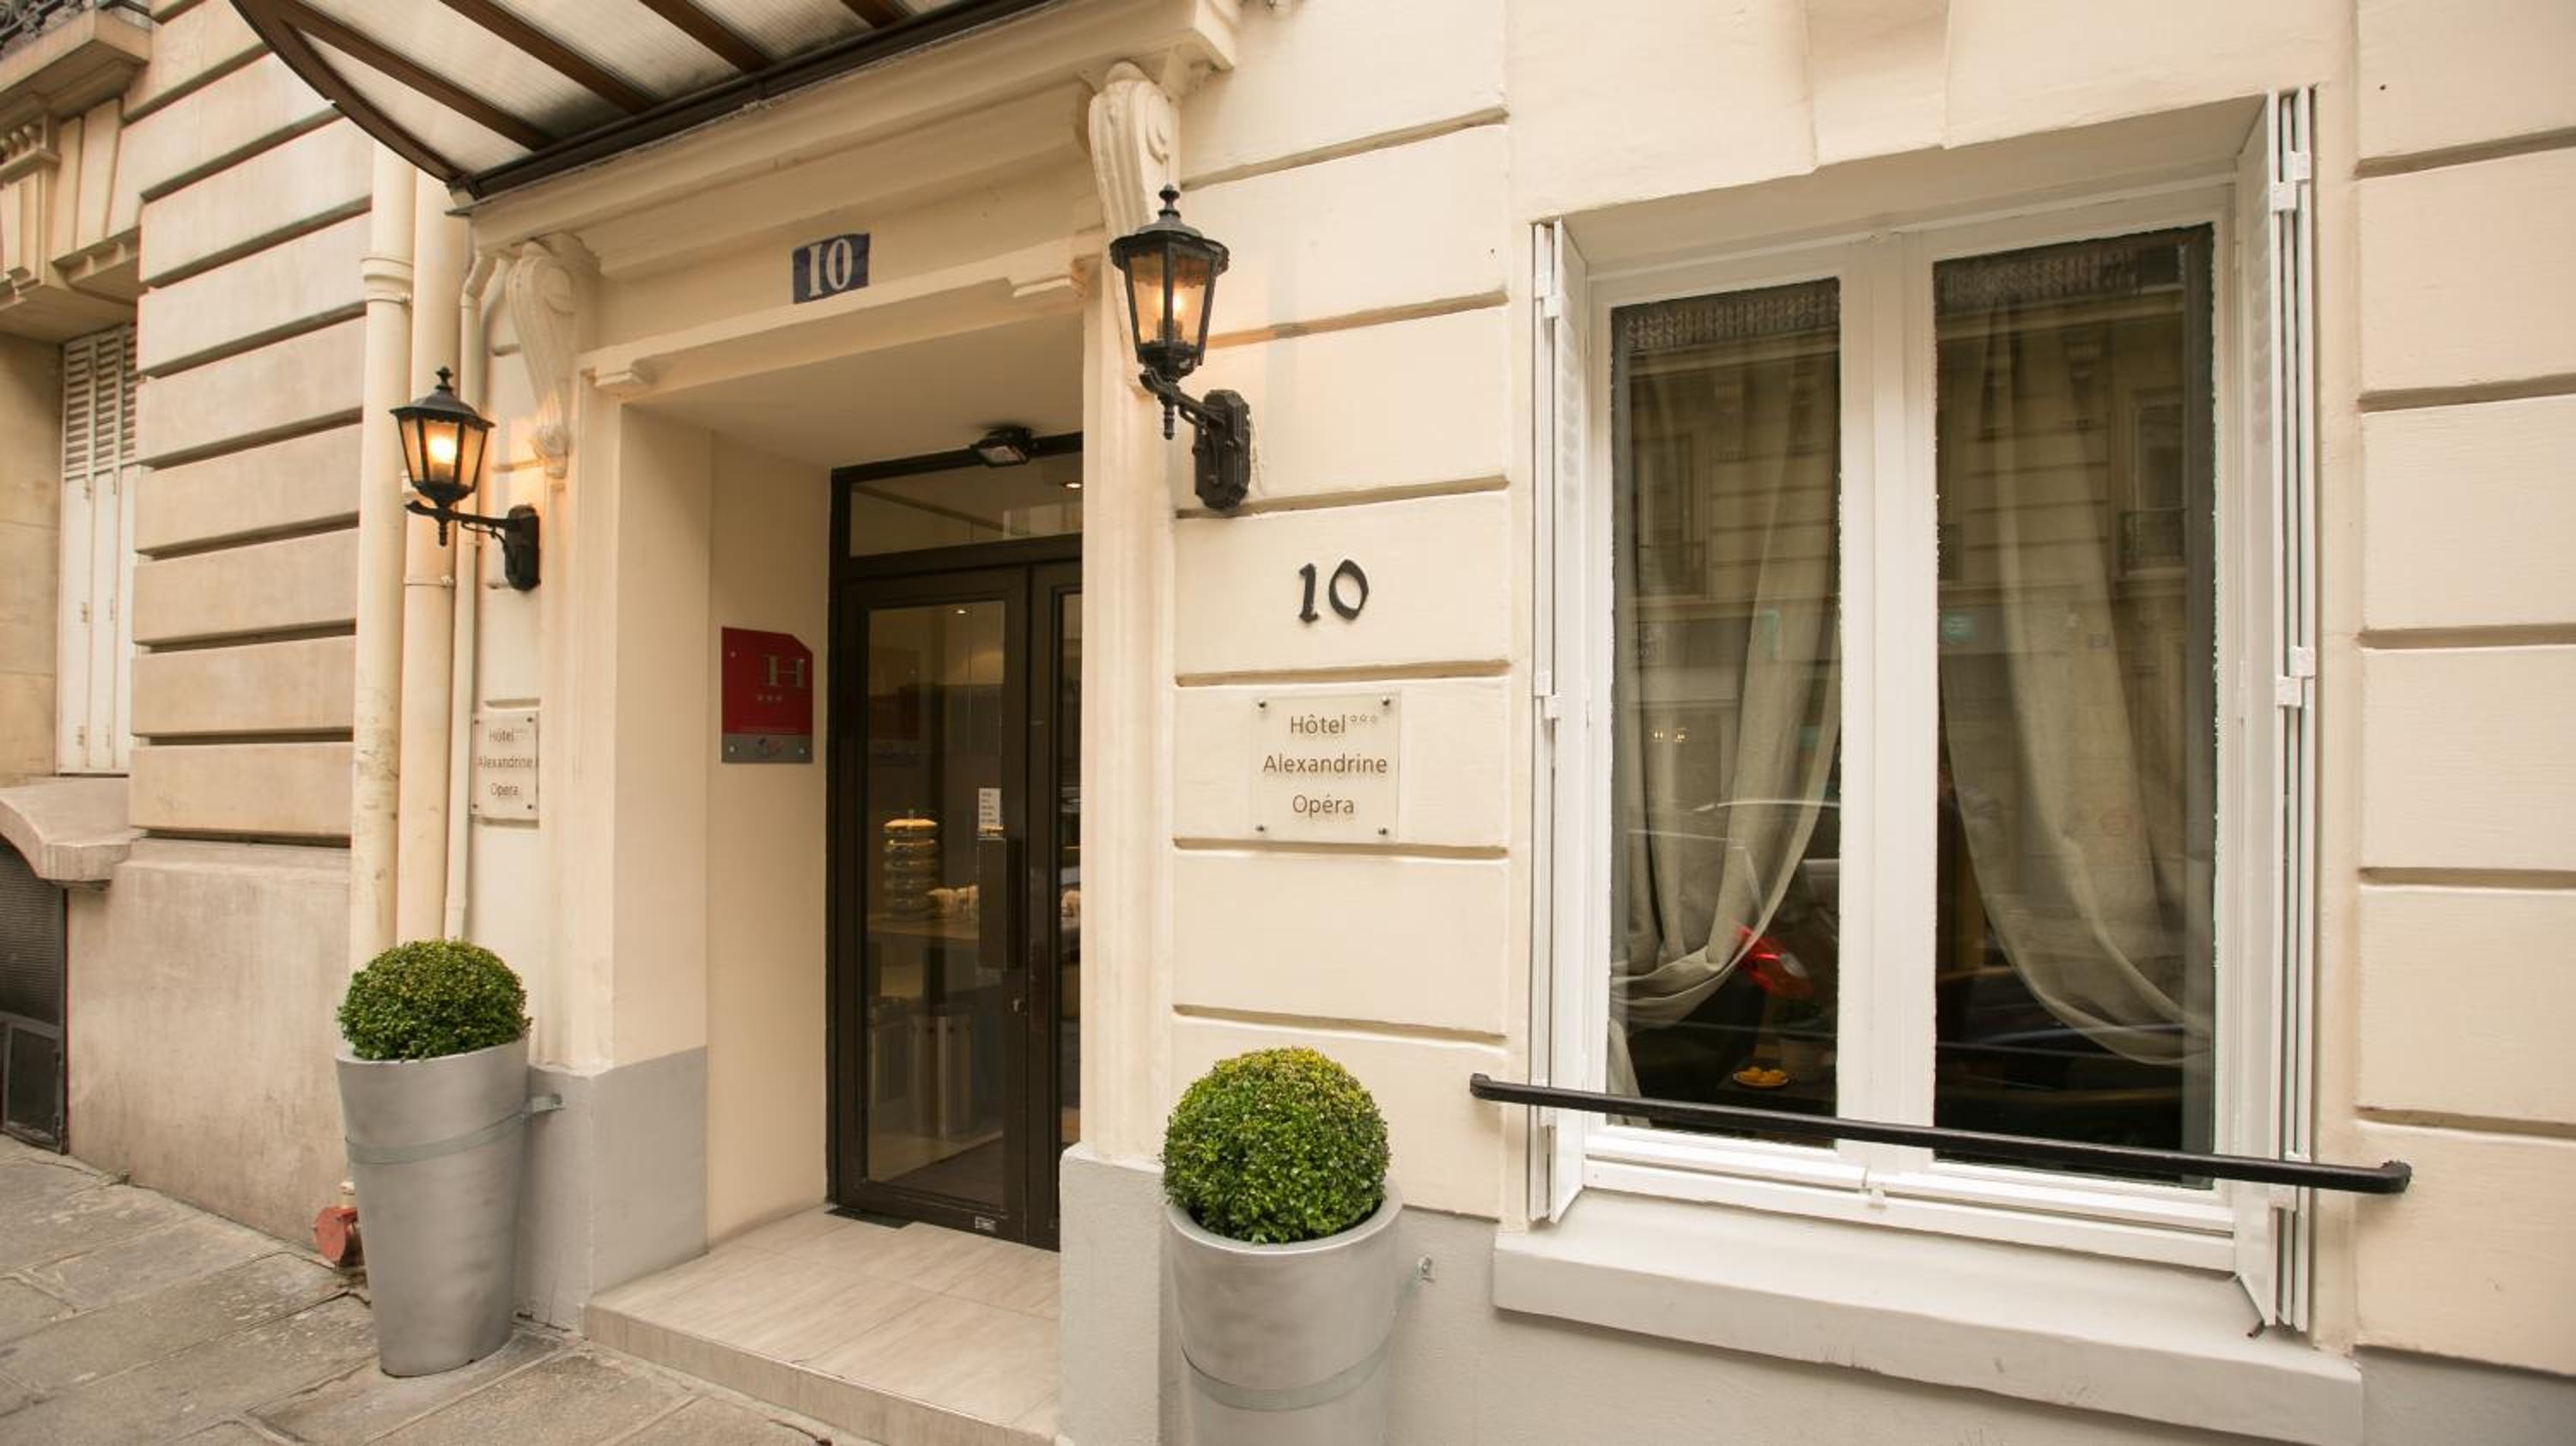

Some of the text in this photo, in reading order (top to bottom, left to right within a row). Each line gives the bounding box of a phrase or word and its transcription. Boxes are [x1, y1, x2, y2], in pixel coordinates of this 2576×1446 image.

[809, 237, 853, 297] 10
[1298, 558, 1370, 623] 10
[1291, 714, 1346, 734] Hôtel
[1263, 753, 1388, 774] Alexandrine
[1292, 793, 1354, 817] Opéra
